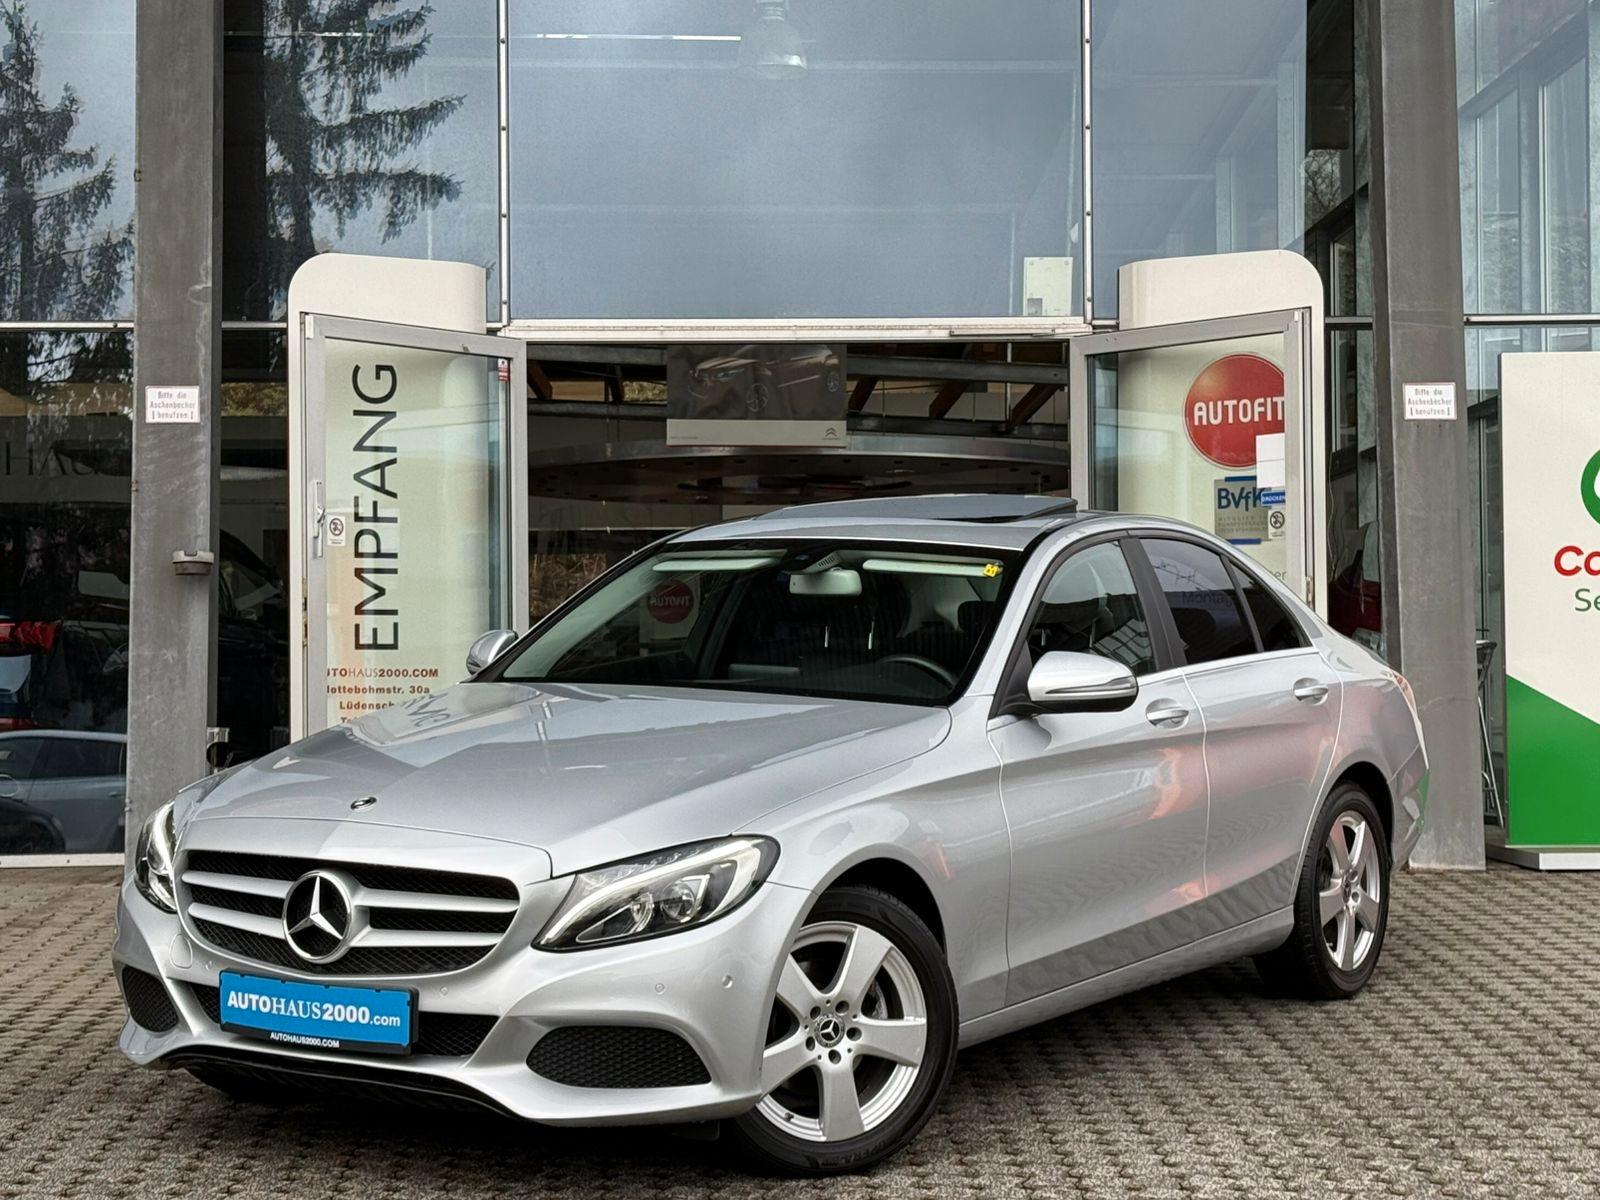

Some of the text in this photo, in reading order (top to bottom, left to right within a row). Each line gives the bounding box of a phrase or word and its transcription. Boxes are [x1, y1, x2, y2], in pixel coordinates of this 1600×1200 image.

[1193, 396, 1285, 426] AUTOFIT
[351, 363, 399, 651] EMPFANG
[408, 685, 431, 694] 30a
[227, 990, 401, 1027] AUTOHAUS2000.com
[269, 1031, 340, 1049] AUTOHAUS2000.COM
